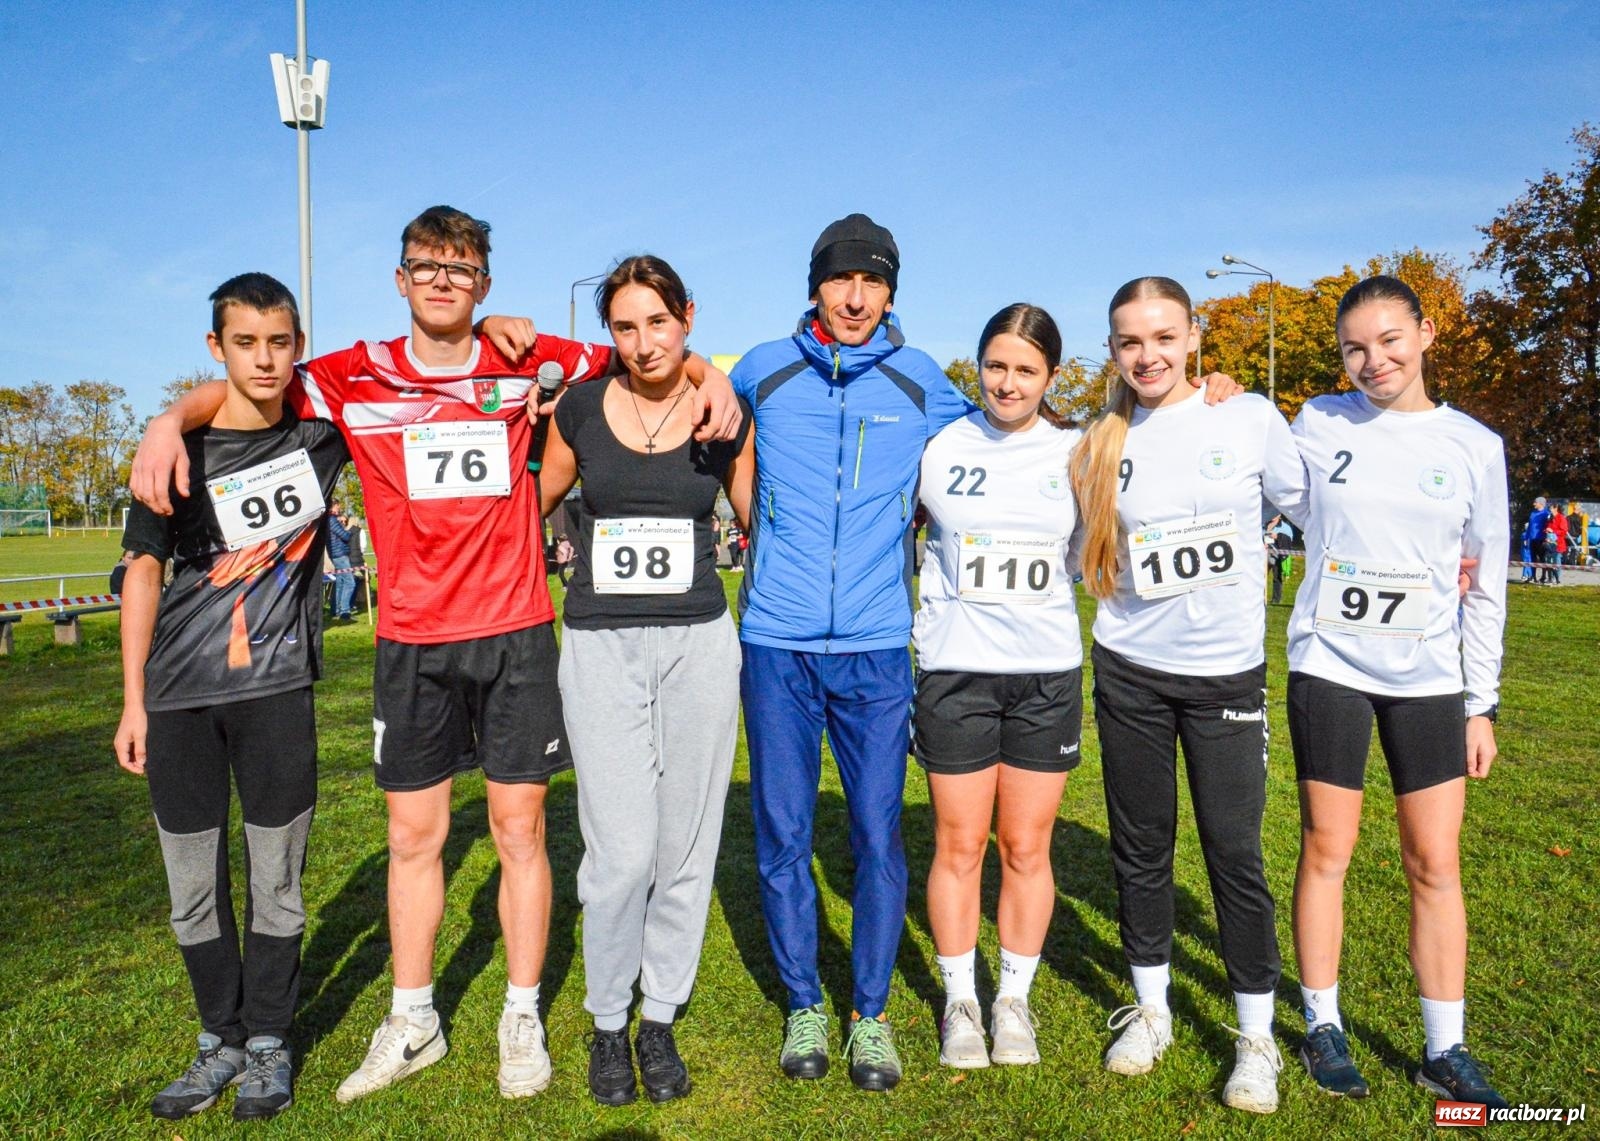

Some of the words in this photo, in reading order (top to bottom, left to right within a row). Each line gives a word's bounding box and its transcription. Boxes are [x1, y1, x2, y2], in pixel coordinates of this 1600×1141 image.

[427, 448, 488, 484] 76
[946, 465, 987, 496] 22
[1328, 450, 1353, 484] 2
[241, 484, 302, 529] 96
[1166, 519, 1232, 536] www.personalbest.pl
[613, 546, 671, 579] 98
[966, 556, 1050, 591] 110
[1141, 540, 1234, 584] 109
[1361, 569, 1428, 580] www.personalbest.pl
[1341, 587, 1406, 624] 97
